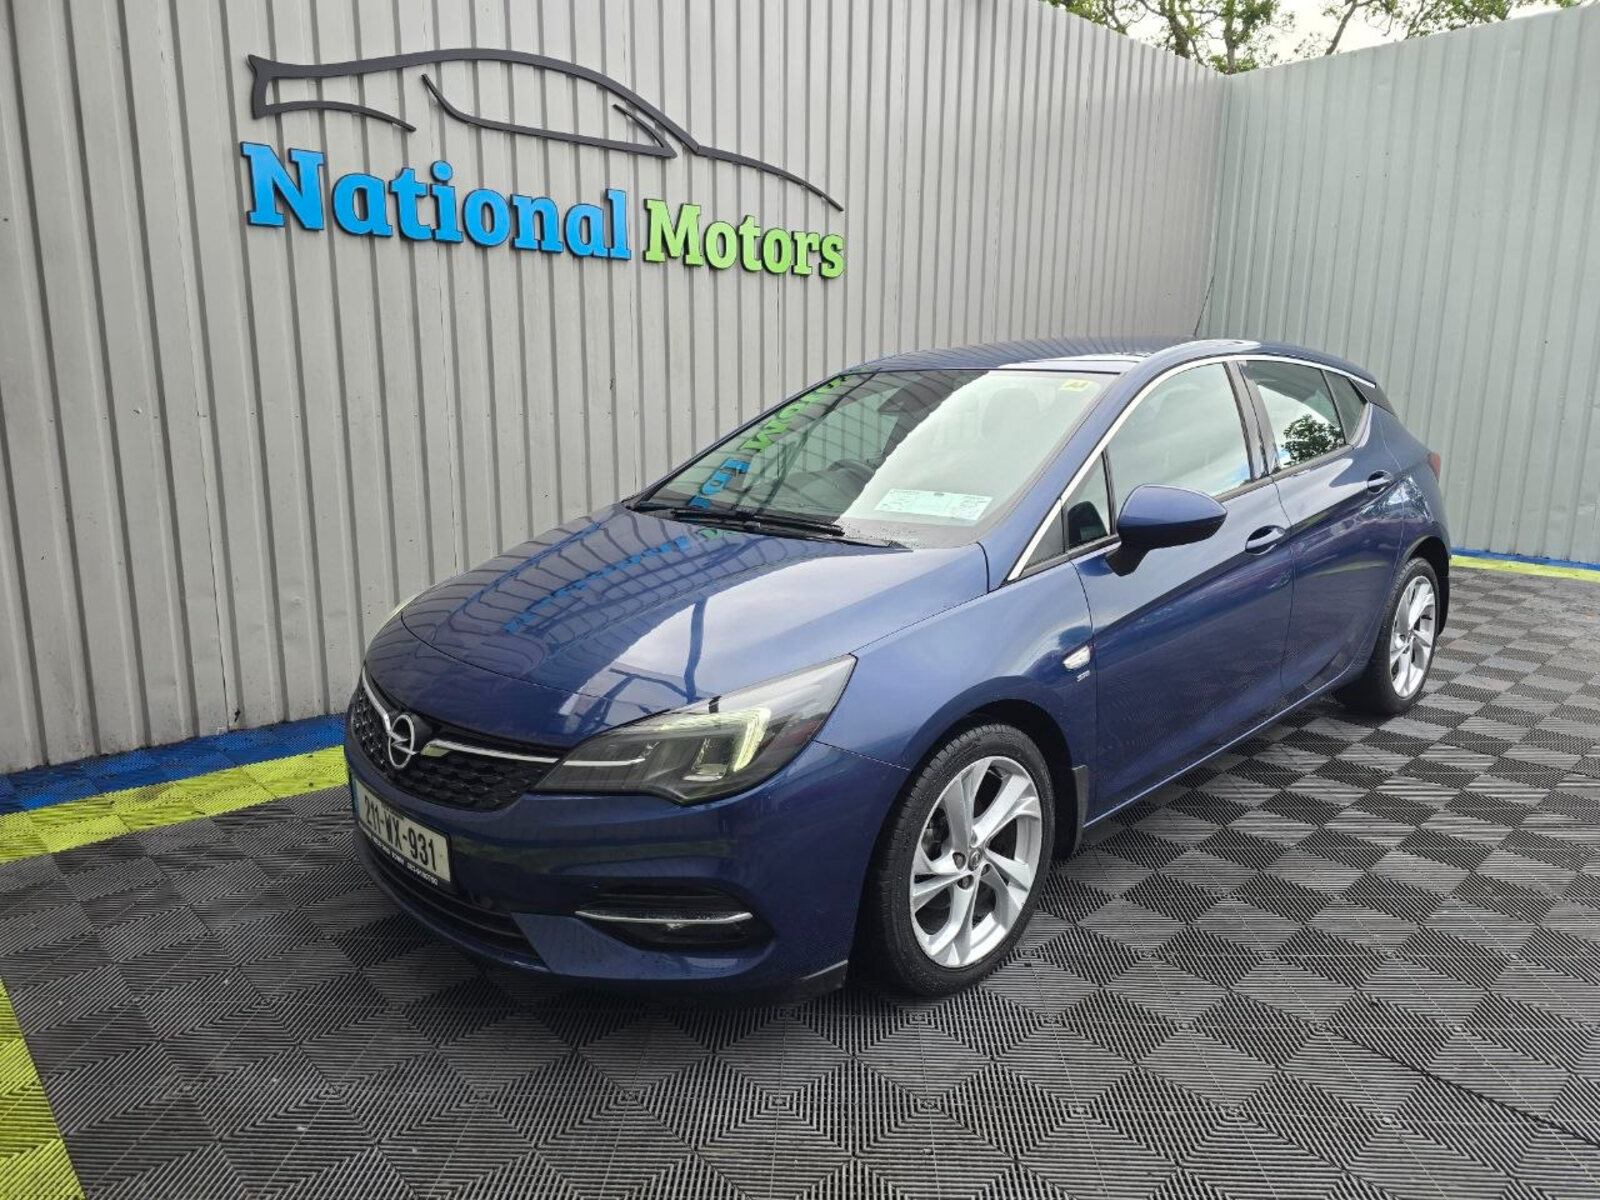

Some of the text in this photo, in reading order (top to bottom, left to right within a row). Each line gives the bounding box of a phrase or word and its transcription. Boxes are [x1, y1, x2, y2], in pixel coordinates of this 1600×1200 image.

[240, 141, 846, 279] National Motors
[364, 794, 437, 871] 211-WX-931
